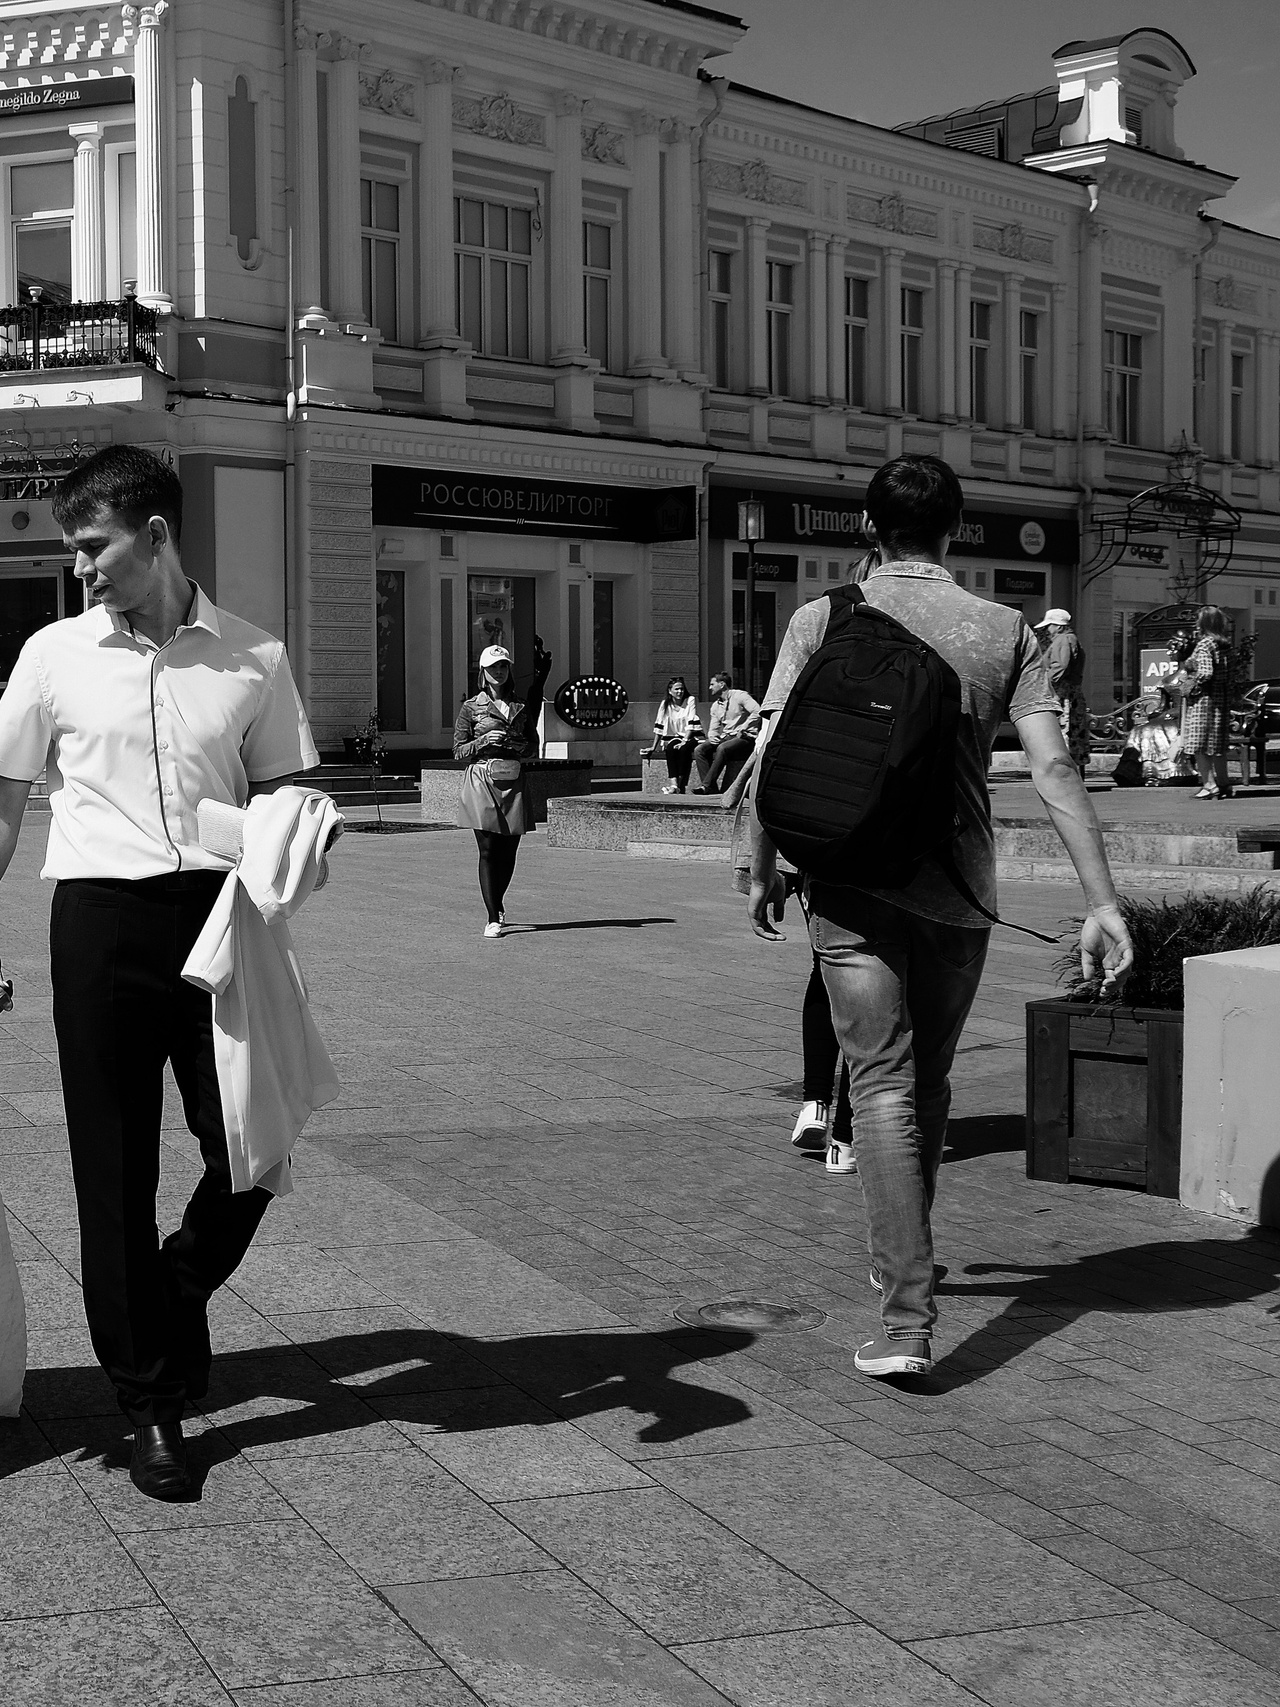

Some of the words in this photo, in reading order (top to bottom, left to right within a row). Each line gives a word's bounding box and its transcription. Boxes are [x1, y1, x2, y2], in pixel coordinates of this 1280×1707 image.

[42, 89, 81, 107] Zegna
[420, 482, 613, 517] РОССЮВЕЛИРТОРГ
[792, 503, 866, 536] Интер
